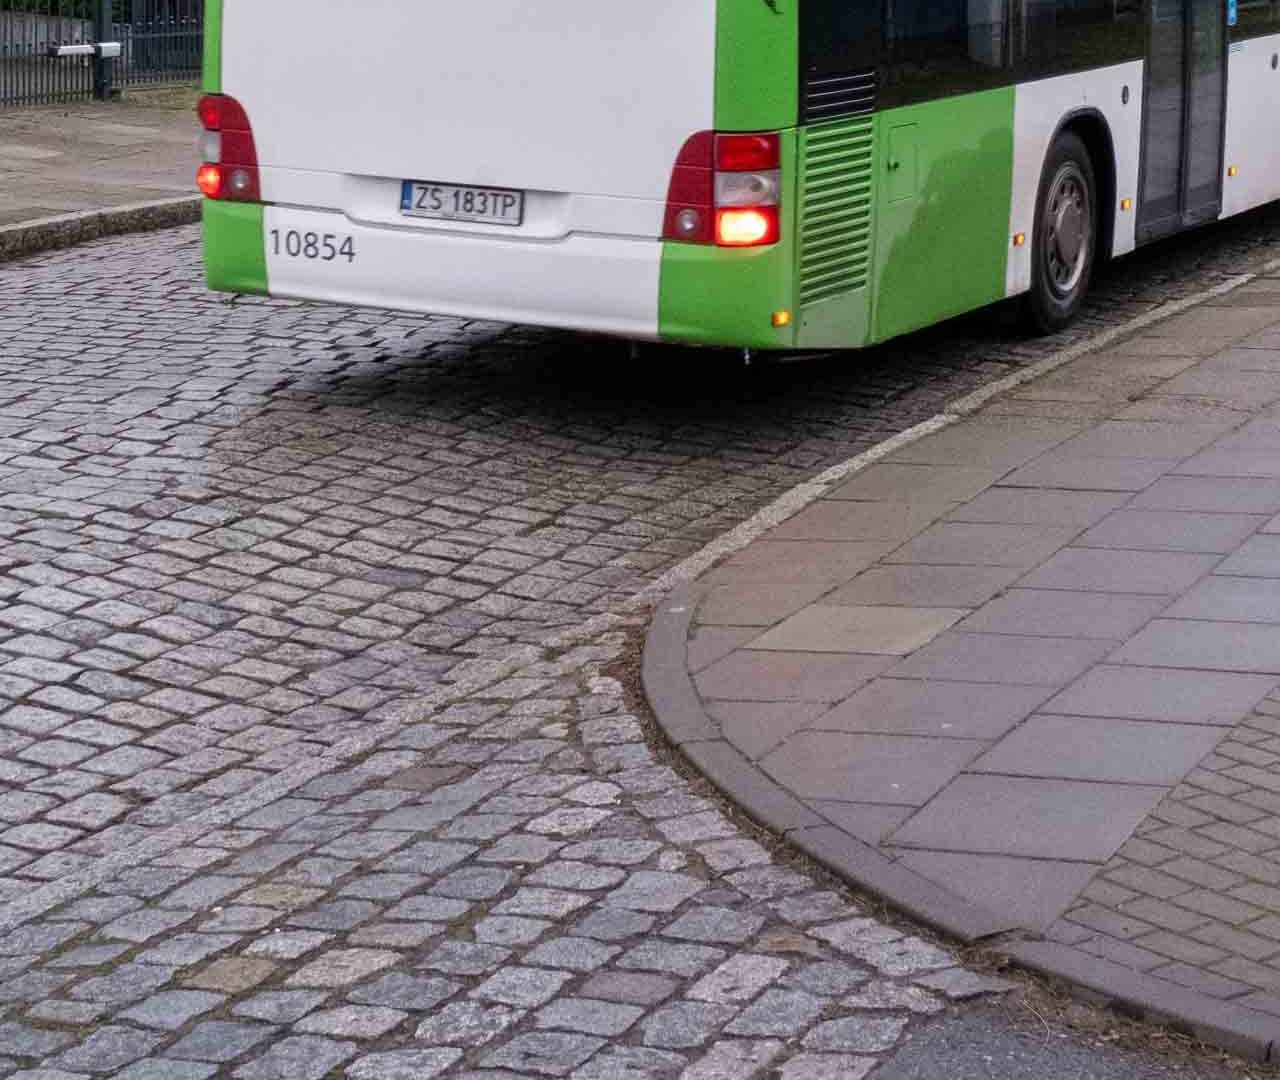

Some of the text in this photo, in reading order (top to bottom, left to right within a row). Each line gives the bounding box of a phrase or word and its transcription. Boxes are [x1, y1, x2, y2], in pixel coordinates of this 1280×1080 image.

[415, 186, 517, 217] ZS 183TP
[270, 229, 356, 263] 10854
